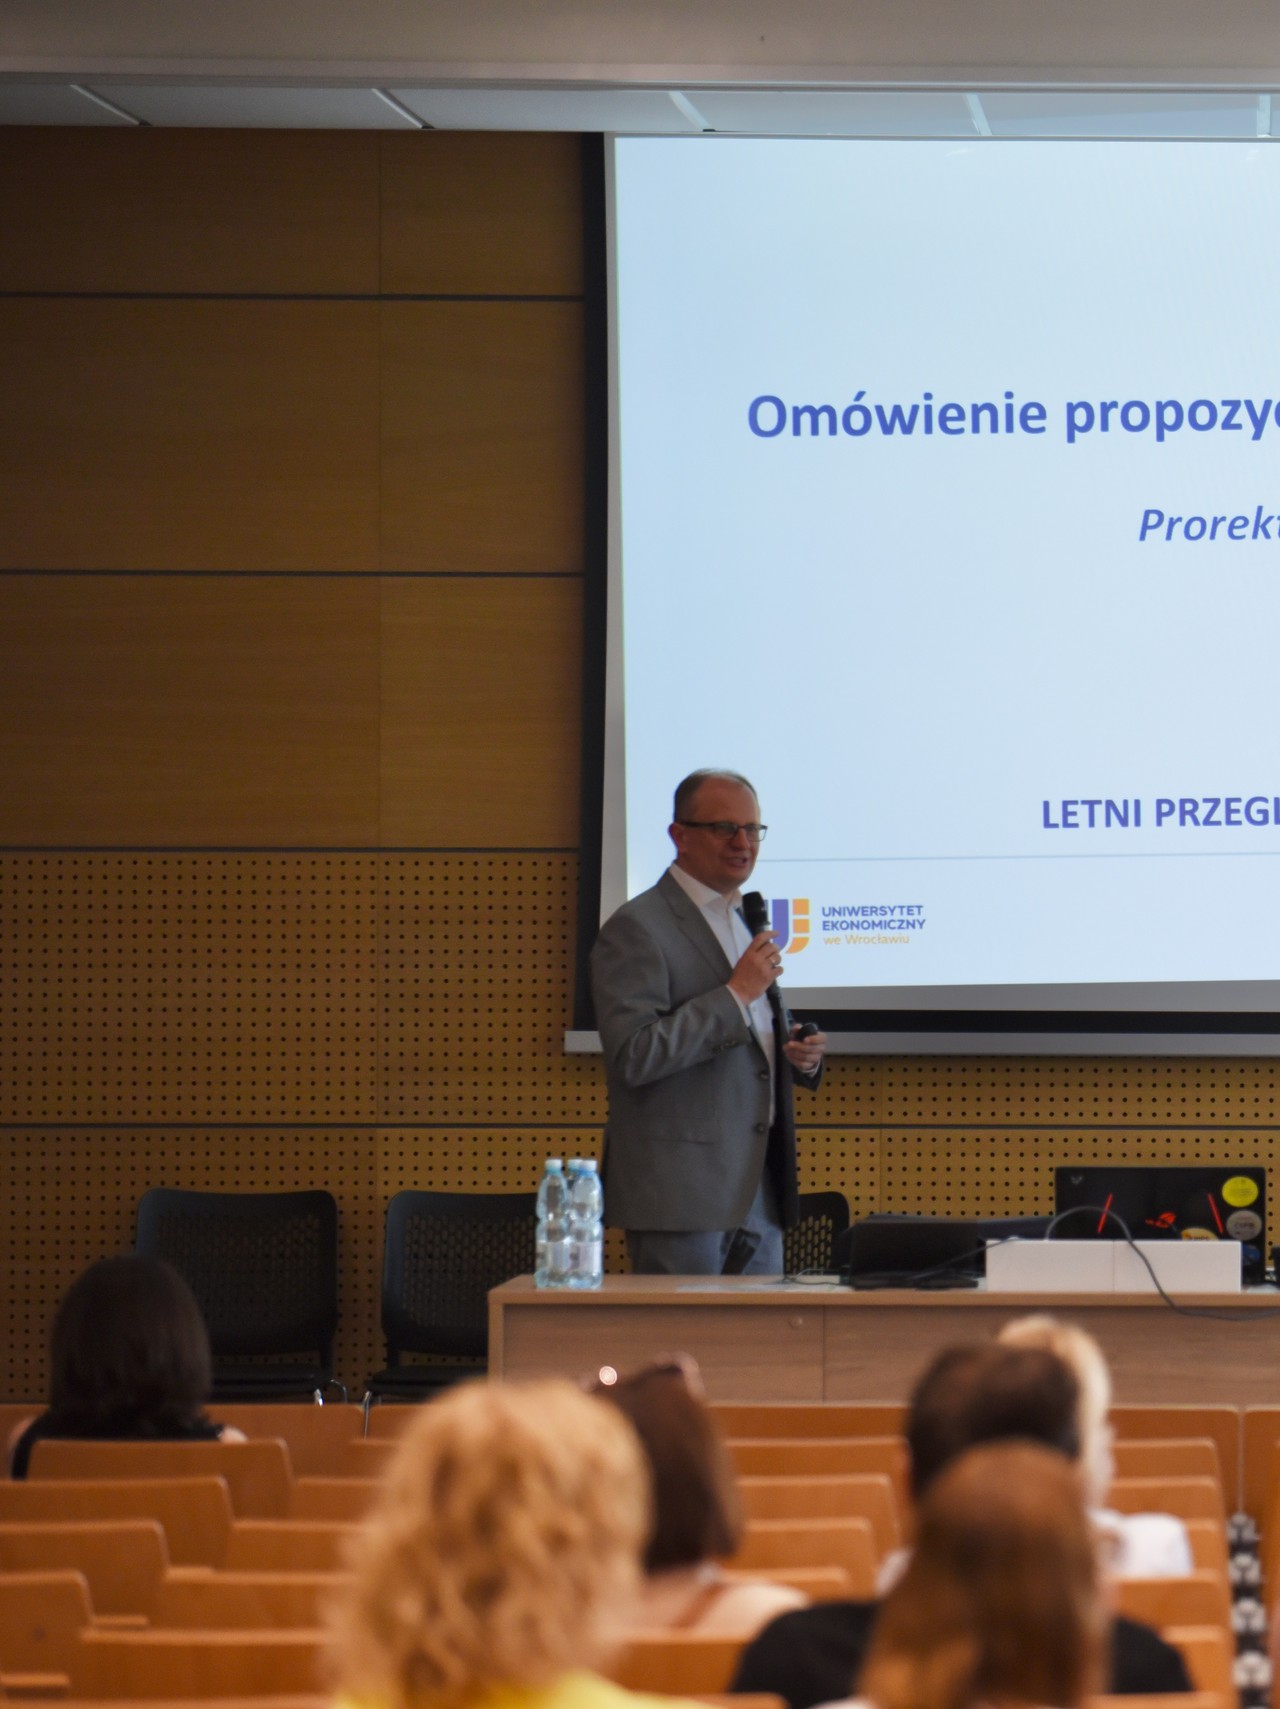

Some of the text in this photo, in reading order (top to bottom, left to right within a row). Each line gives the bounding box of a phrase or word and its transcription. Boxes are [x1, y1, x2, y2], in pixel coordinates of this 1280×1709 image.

[748, 391, 1047, 438] Omówienie
[1043, 799, 1141, 828] LETNI
[822, 905, 923, 917] UNIWERSYTET
[822, 919, 926, 931] EKONOMICZNY
[823, 932, 910, 945] we Wrocławiu
